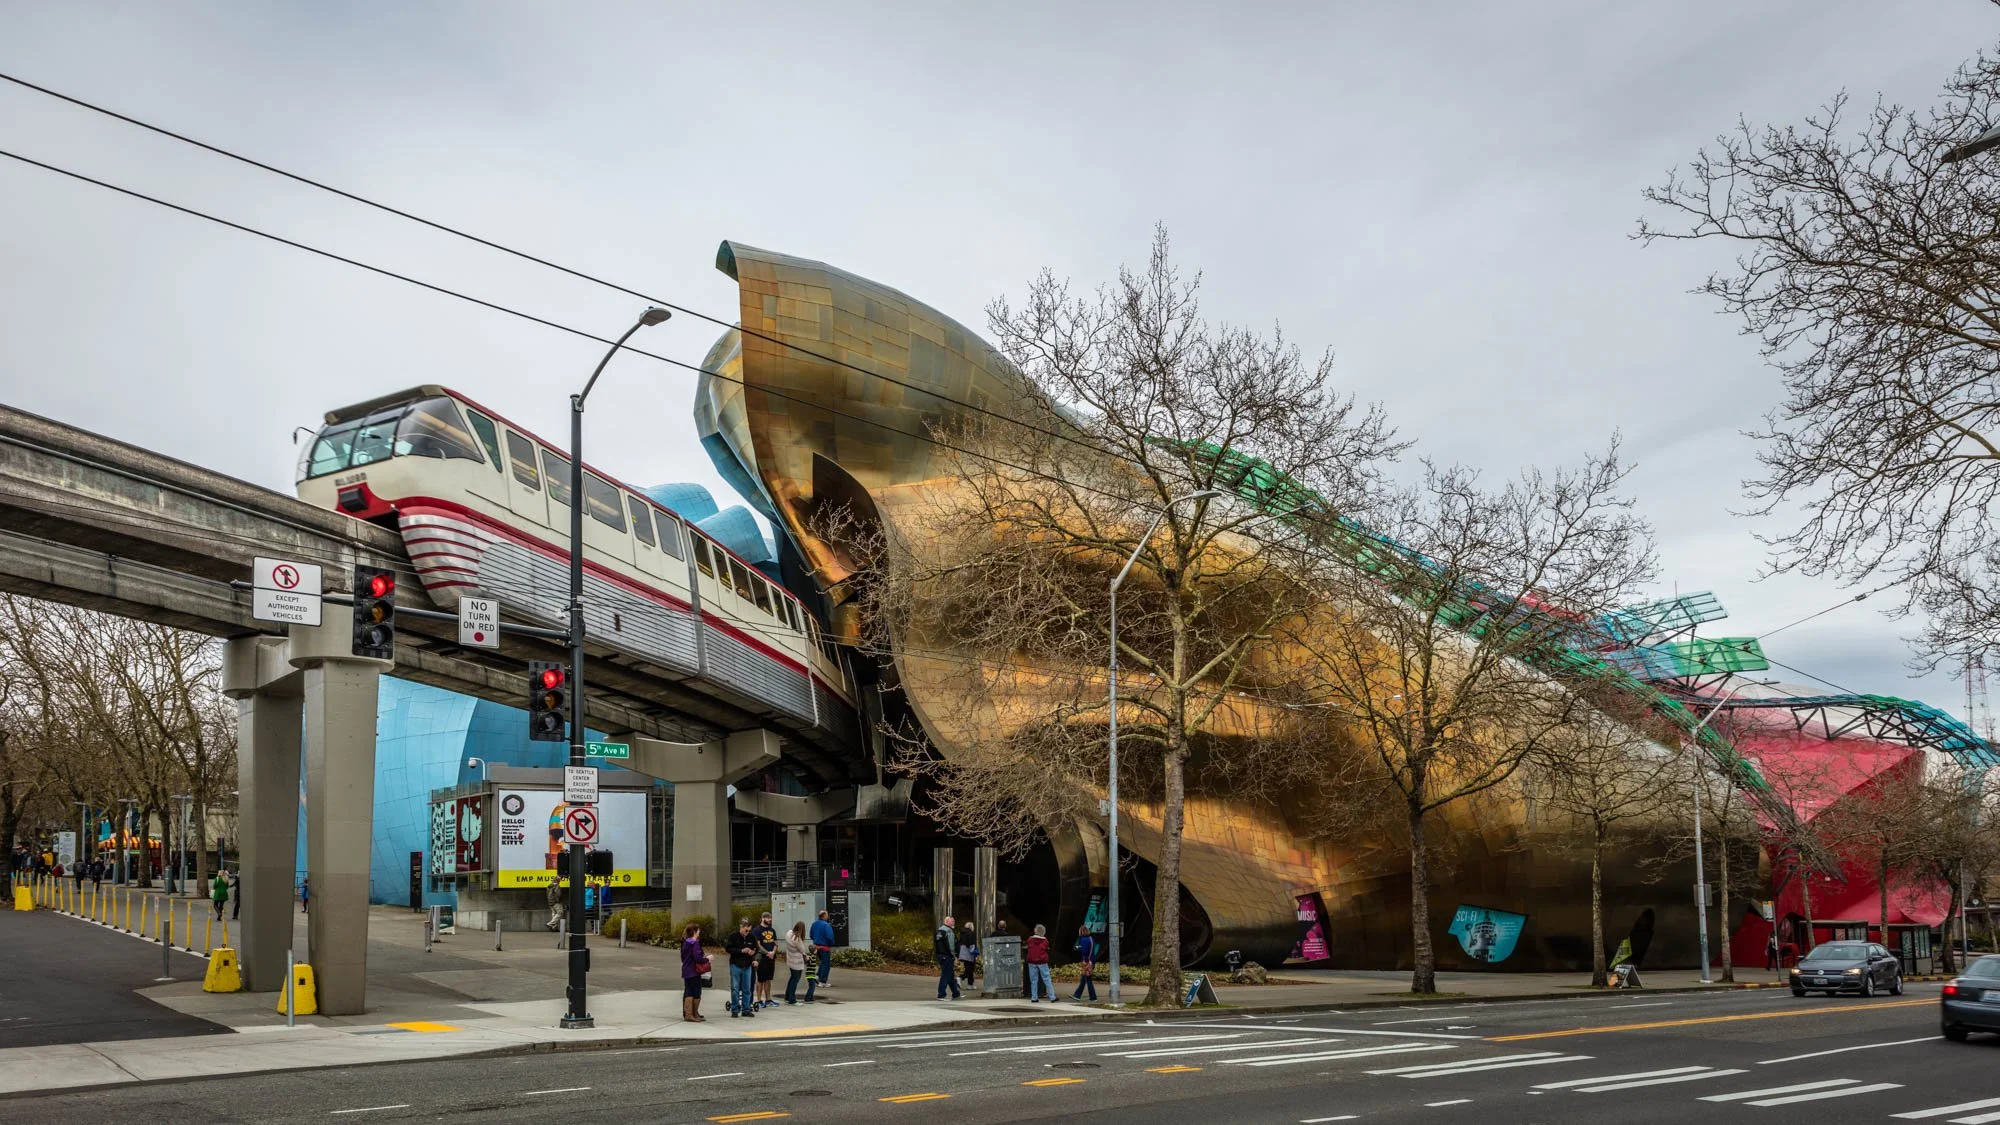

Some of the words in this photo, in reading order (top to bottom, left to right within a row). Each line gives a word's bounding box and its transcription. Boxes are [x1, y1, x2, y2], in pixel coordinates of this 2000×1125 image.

[268, 603, 307, 612] AUTHORIZED
[471, 601, 488, 611] NO
[272, 612, 303, 620] VEHICLES
[468, 612, 491, 621] TURN
[463, 621, 474, 629] ON
[478, 623, 495, 631] RED
[603, 746, 618, 755] Ave
[619, 747, 626, 755] N
[1297, 910, 1316, 921] MUSIC
[1456, 910, 1477, 921] SCI-FI
